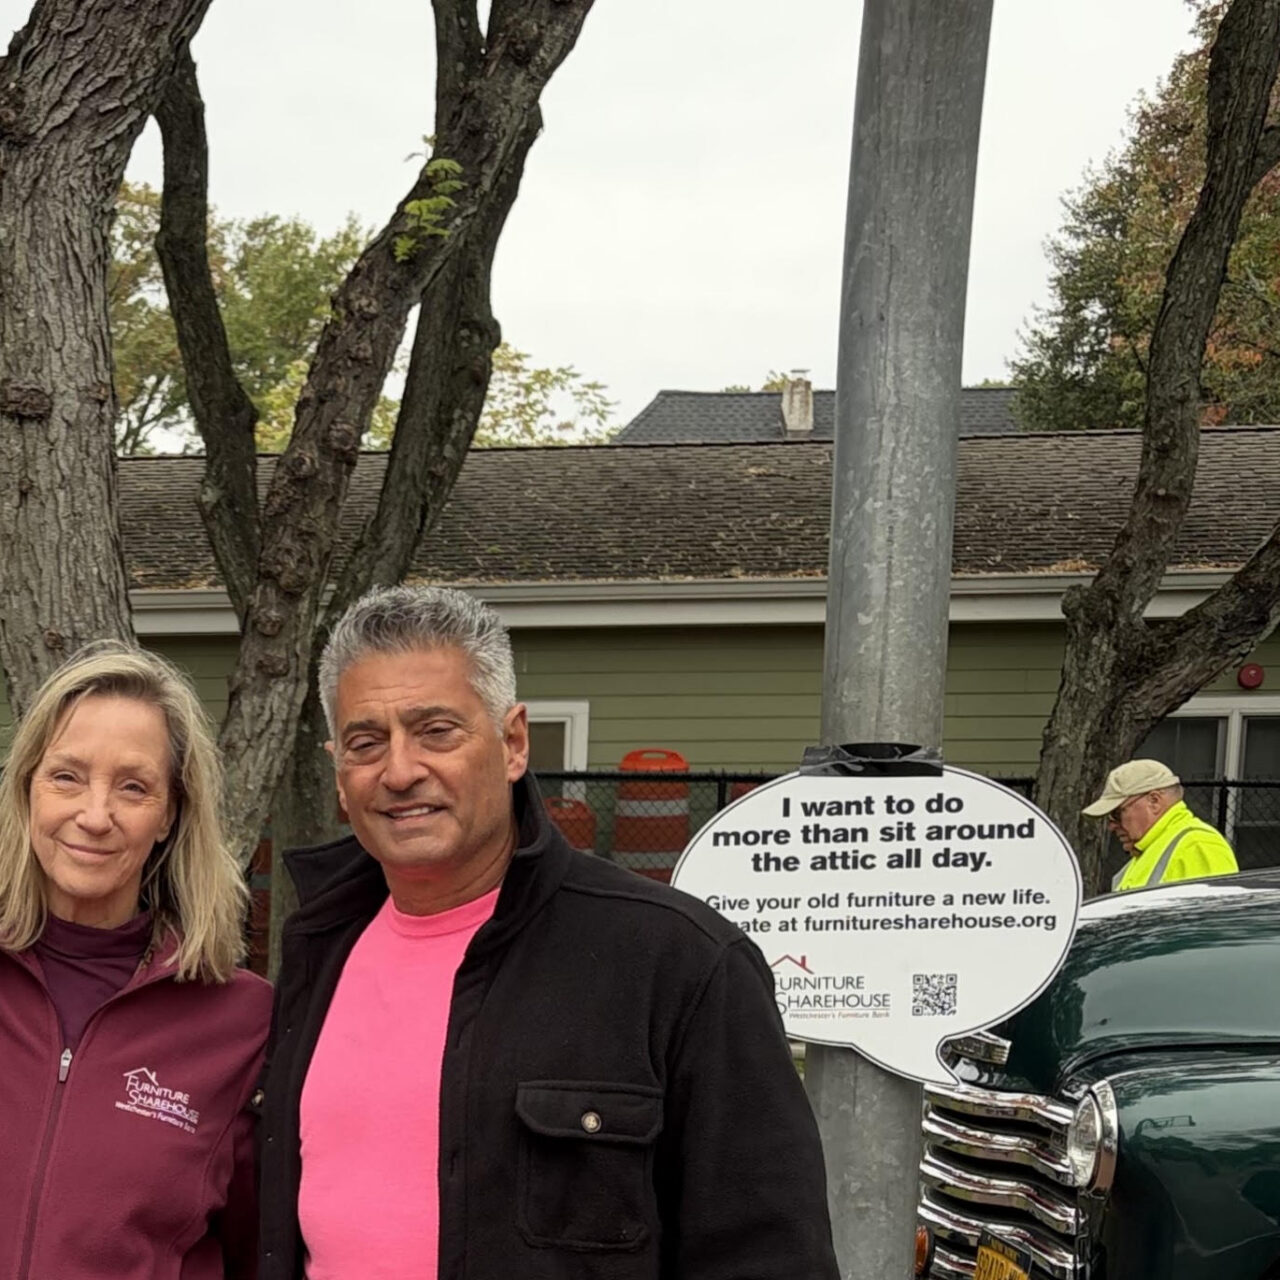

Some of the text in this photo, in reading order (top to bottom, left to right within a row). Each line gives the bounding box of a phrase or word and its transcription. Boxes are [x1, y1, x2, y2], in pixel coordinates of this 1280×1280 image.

[782, 793, 964, 818] I want to do
[712, 818, 1035, 847] more than sit around
[751, 847, 992, 873] the attic all day.
[705, 889, 1051, 914] Give your old furniture a new life.
[739, 913, 1058, 933] ate at furnituresharehouse.org
[774, 991, 891, 1015] SHAREHOUSE
[125, 1074, 191, 1105] FURNITURE
